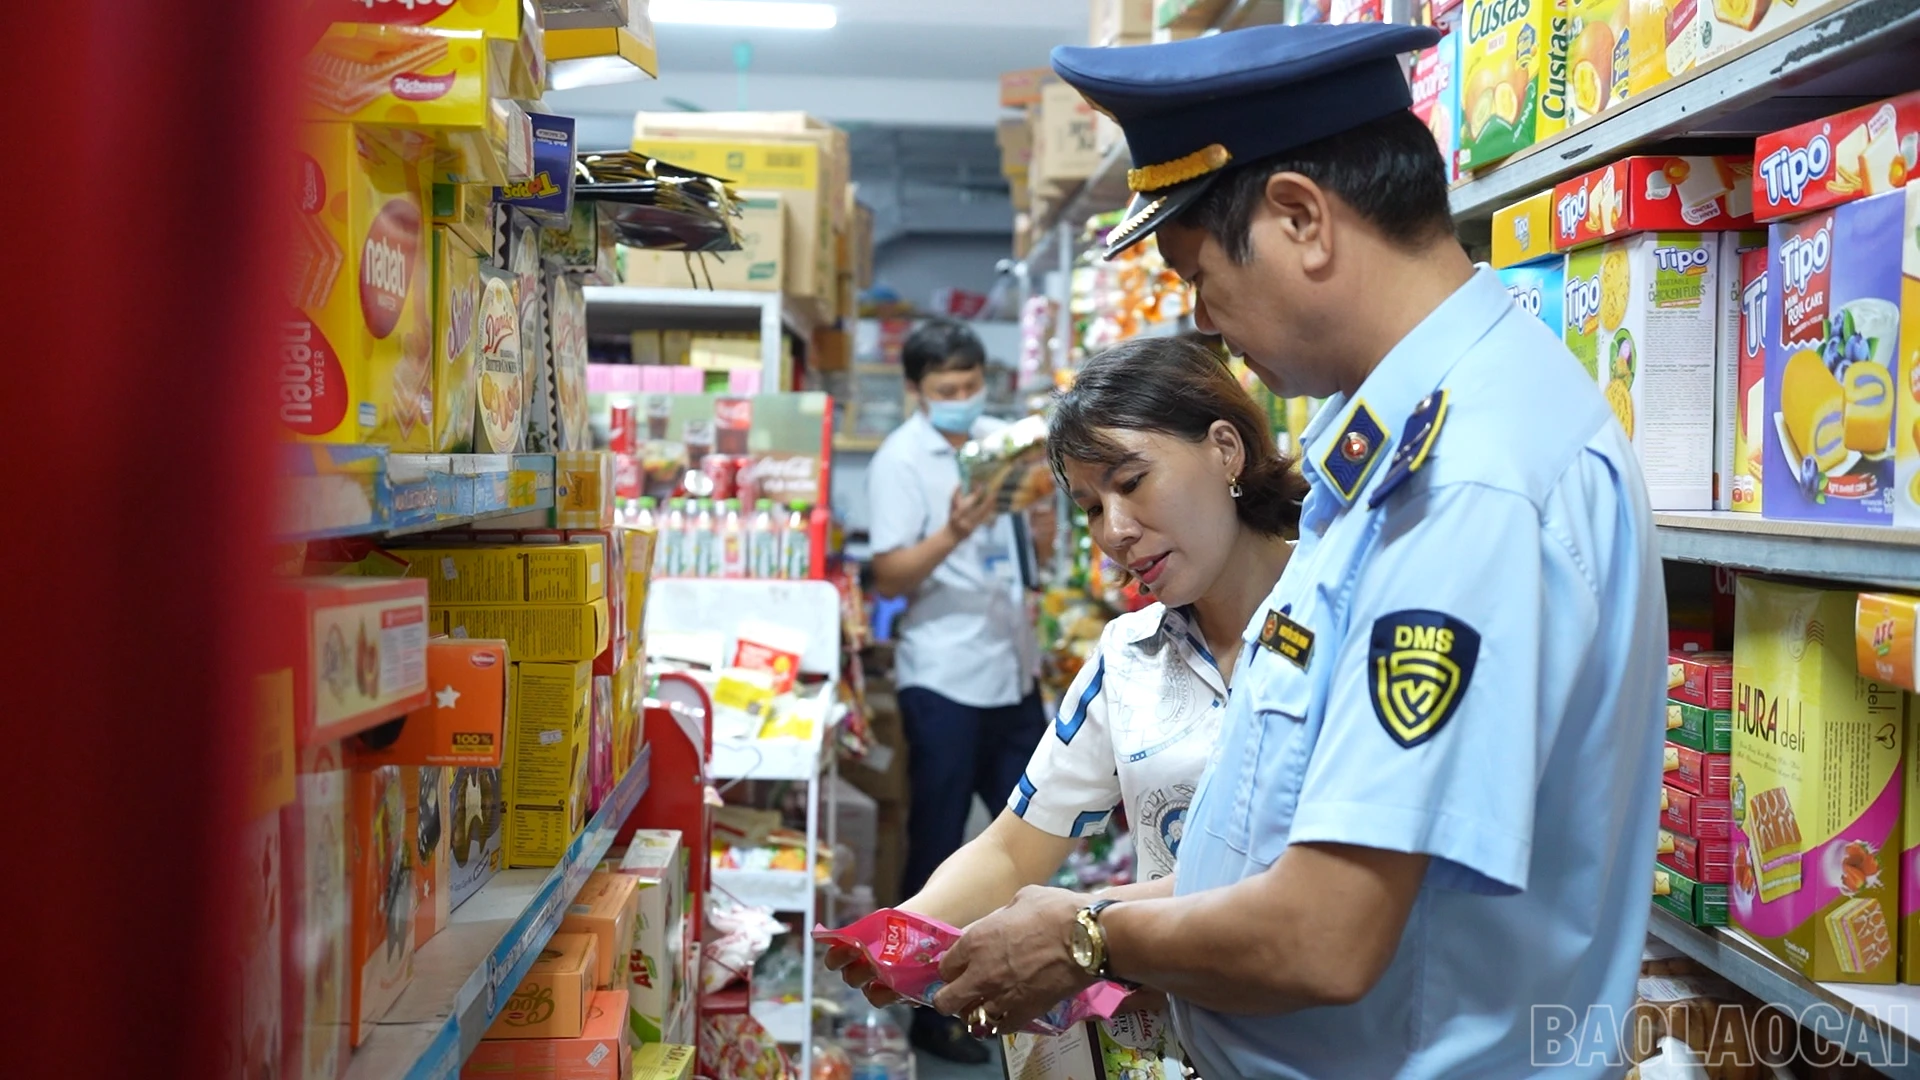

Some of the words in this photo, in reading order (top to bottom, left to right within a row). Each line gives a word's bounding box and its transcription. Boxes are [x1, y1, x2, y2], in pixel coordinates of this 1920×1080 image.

[1468, 0, 1530, 44] Custas
[1760, 133, 1830, 206] Tipo
[1558, 187, 1587, 239] Tipo
[1654, 247, 1709, 273] Tipo
[1780, 228, 1830, 296] Tipo
[1566, 275, 1600, 334] Tipo
[1742, 271, 1767, 357] Ti
[313, 350, 325, 398] WAFER
[1394, 625, 1454, 653] DMS
[1873, 620, 1894, 648] AFC
[1737, 681, 1778, 745] HURA
[1780, 698, 1805, 753] deli
[1868, 683, 1897, 714] deli
[884, 925, 900, 956] HURA
